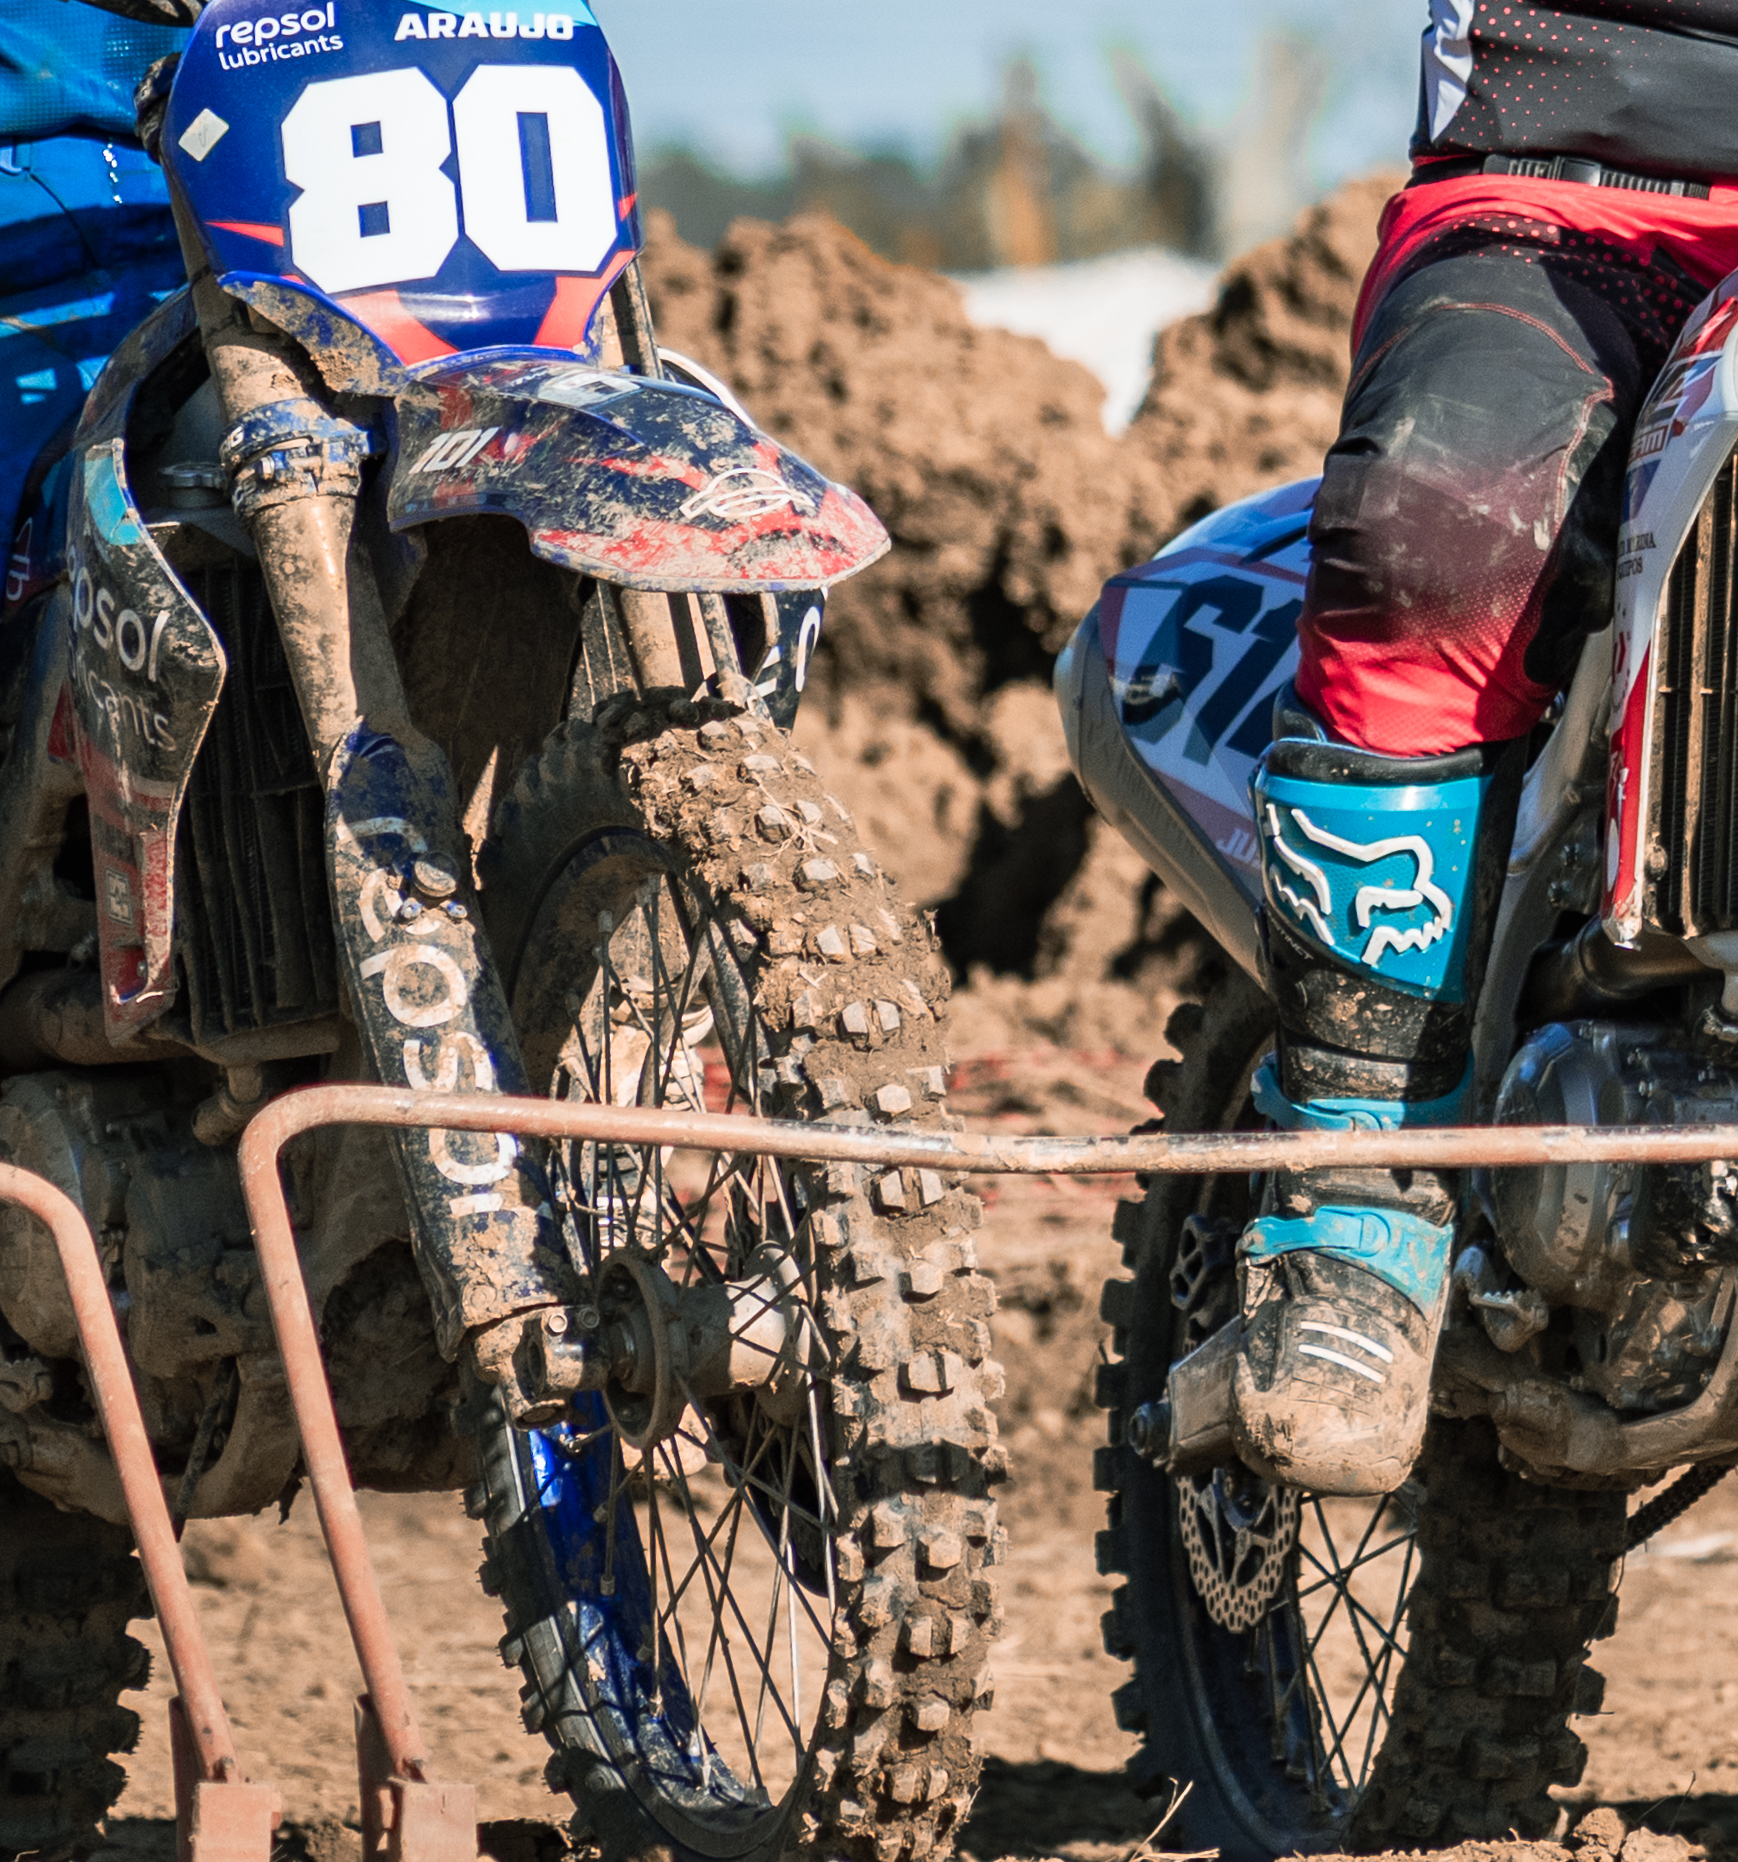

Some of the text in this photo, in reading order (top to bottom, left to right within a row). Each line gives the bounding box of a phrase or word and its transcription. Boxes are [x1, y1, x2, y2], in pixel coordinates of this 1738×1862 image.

[215, 1, 337, 47] repsol
[394, 12, 575, 41] ARAUJO
[218, 33, 344, 71] lubricants
[281, 65, 618, 294] 80
[408, 426, 502, 475] 101
